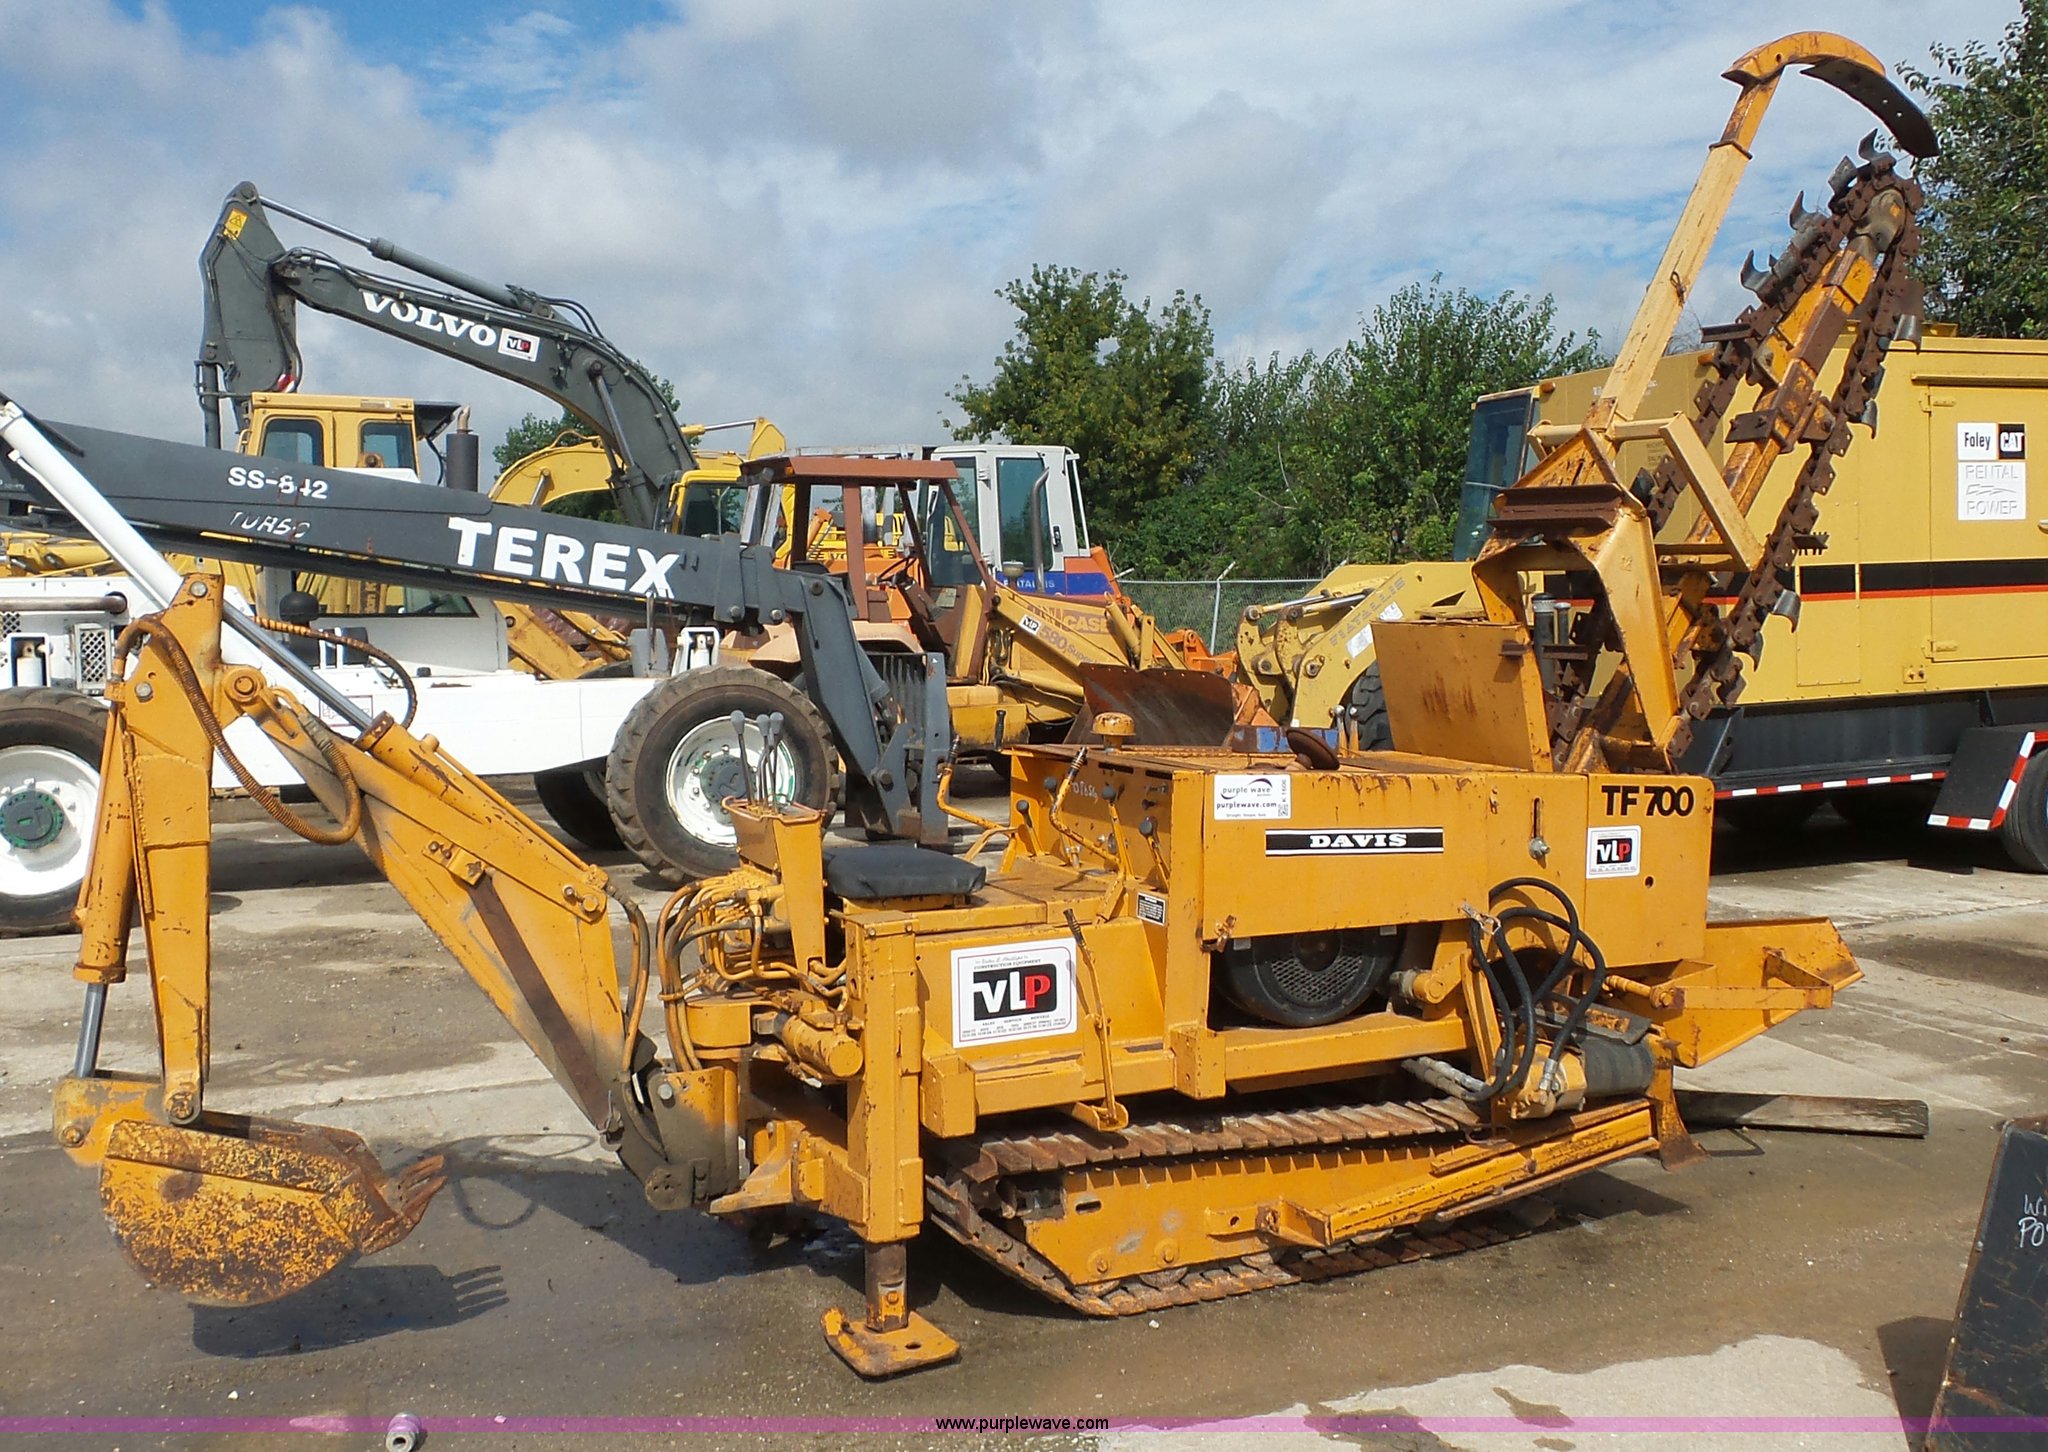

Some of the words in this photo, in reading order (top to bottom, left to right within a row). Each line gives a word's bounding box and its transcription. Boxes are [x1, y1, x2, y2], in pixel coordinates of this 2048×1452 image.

[359, 288, 497, 346] VOLVO
[1964, 432, 1991, 451] Foley
[2000, 432, 2025, 452] CAT
[228, 466, 328, 499] SS-842
[1965, 465, 2020, 479] RENTAL
[1967, 500, 2018, 515] POWER
[448, 517, 680, 599] TEREX
[1039, 624, 1068, 650] 580
[1222, 787, 1248, 795] purple
[1601, 785, 1640, 816] TF
[1643, 785, 1695, 817] 700
[1216, 801, 1277, 810] purplewave.com
[1309, 833, 1408, 848] DAVIS
[1597, 839, 1632, 863] VLP
[973, 970, 1052, 1014] VLP
[2018, 1216, 2048, 1248] PO
